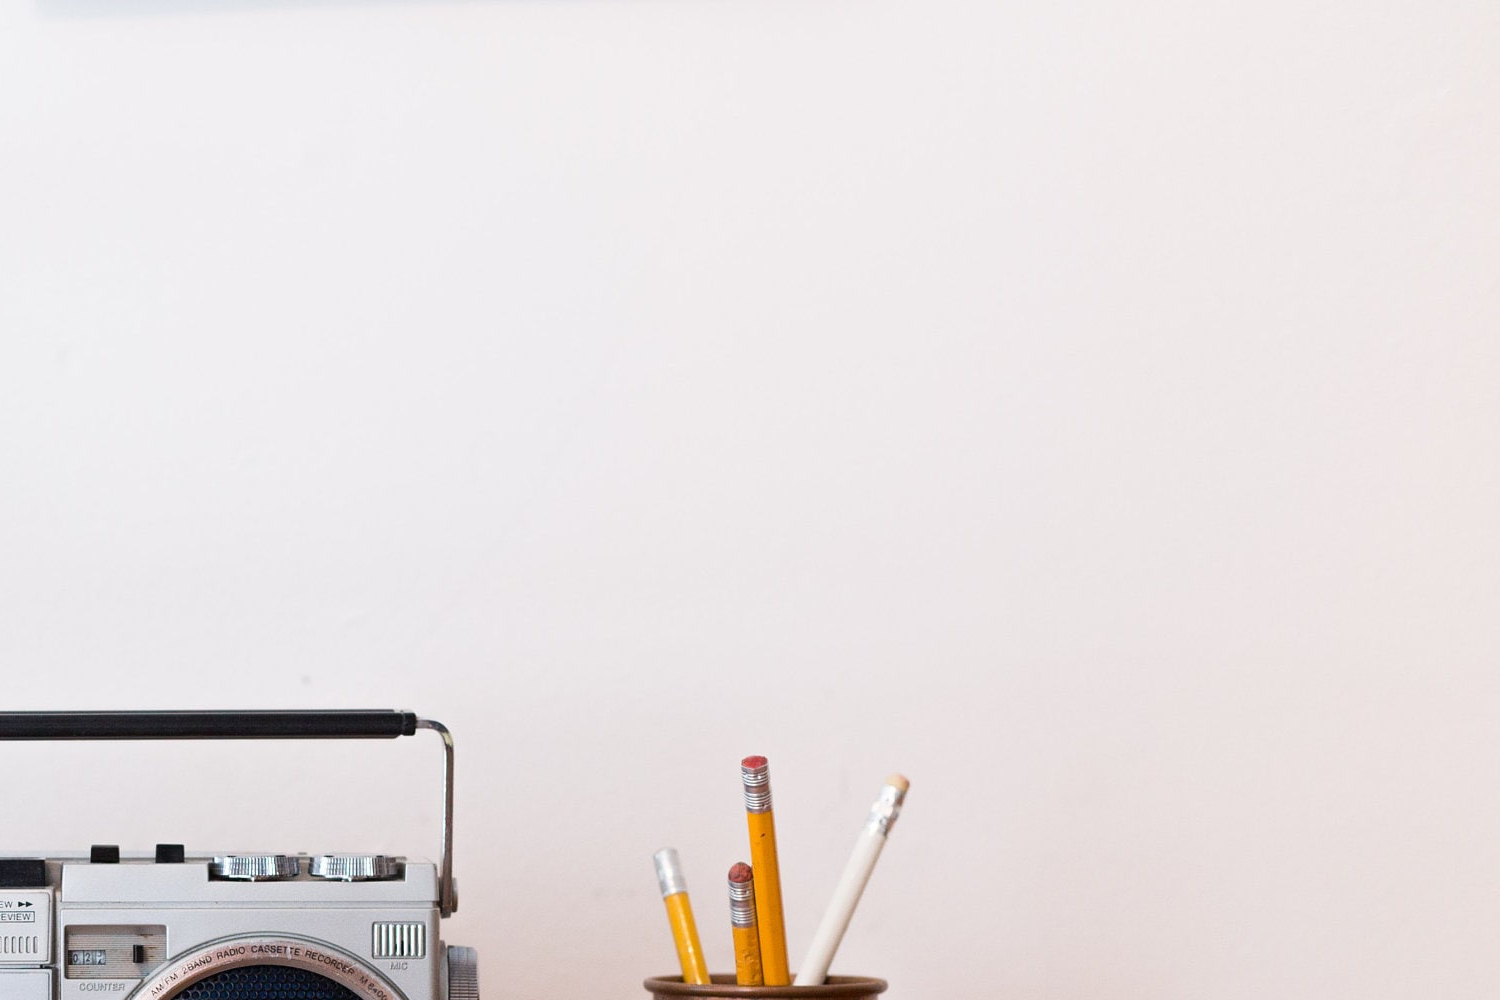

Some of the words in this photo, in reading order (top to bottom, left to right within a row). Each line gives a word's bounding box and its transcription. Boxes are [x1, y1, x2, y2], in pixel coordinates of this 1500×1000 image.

[216, 946, 246, 960] RADIO
[250, 945, 300, 957] CASSETTE
[304, 950, 355, 975] RECORDER
[390, 962, 408, 971] MIC
[79, 982, 126, 992] COUNTER
